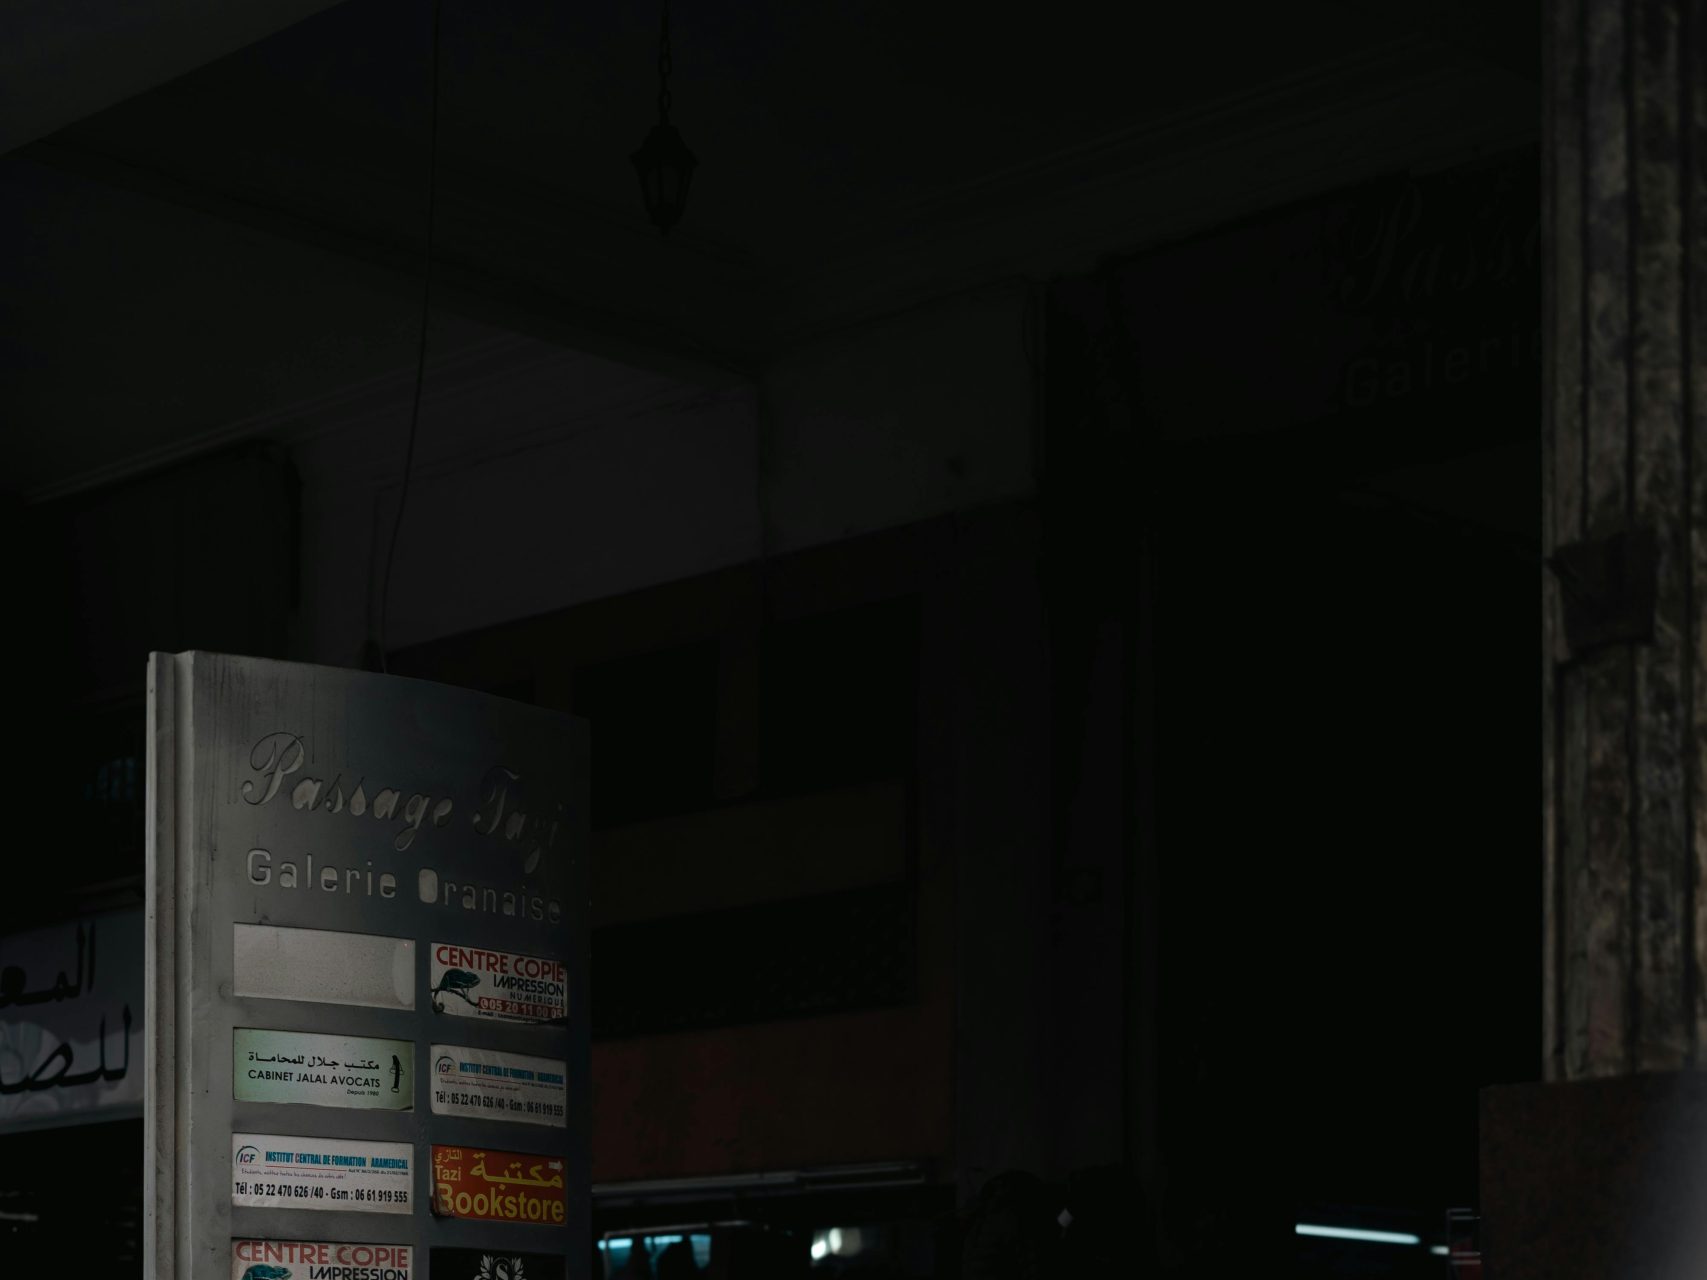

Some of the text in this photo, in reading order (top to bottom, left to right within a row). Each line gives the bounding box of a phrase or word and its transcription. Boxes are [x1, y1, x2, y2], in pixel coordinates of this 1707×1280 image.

[241, 732, 563, 874] Passage Tazi
[247, 848, 561, 925] Galerie Oranaise
[436, 946, 564, 982] CENTRE COPIE
[494, 974, 564, 996] IMPRESSION
[488, 999, 502, 1011] 05
[506, 1001, 518, 1014] 20
[522, 1004, 533, 1016] 11
[536, 1005, 549, 1018] 00
[248, 1051, 379, 1071] مكتب جلال للمحاماة
[248, 1070, 380, 1088] CABINET JALAL AVOCATS
[347, 1089, 365, 1097] Depuis
[436, 1091, 446, 1103] Tél
[451, 1093, 459, 1104] 05
[461, 1094, 468, 1105] 22
[470, 1096, 481, 1106] 470
[483, 1097, 493, 1107] 626
[510, 1100, 522, 1112] Gsm
[527, 1102, 534, 1112] 06
[535, 1103, 541, 1113] 61
[543, 1104, 552, 1115] 919
[554, 1105, 563, 1116] 555
[265, 1151, 408, 1169] INSTITUT CENTRAL DE FORMATION ARAMEDICAL
[470, 1152, 563, 1190] مكتبة
[435, 1165, 461, 1181] Tazi
[236, 1182, 247, 1194] Tél
[254, 1183, 263, 1195] 05
[266, 1184, 275, 1196] 22
[278, 1185, 292, 1197] 470
[294, 1186, 308, 1198] 626
[330, 1187, 348, 1200] Gsm
[355, 1189, 364, 1200] 06
[366, 1189, 375, 1201] 61
[378, 1190, 392, 1202] 919
[394, 1191, 408, 1203] 555
[435, 1183, 564, 1222] Bookstore
[236, 1241, 408, 1268] CENTRE COPIE
